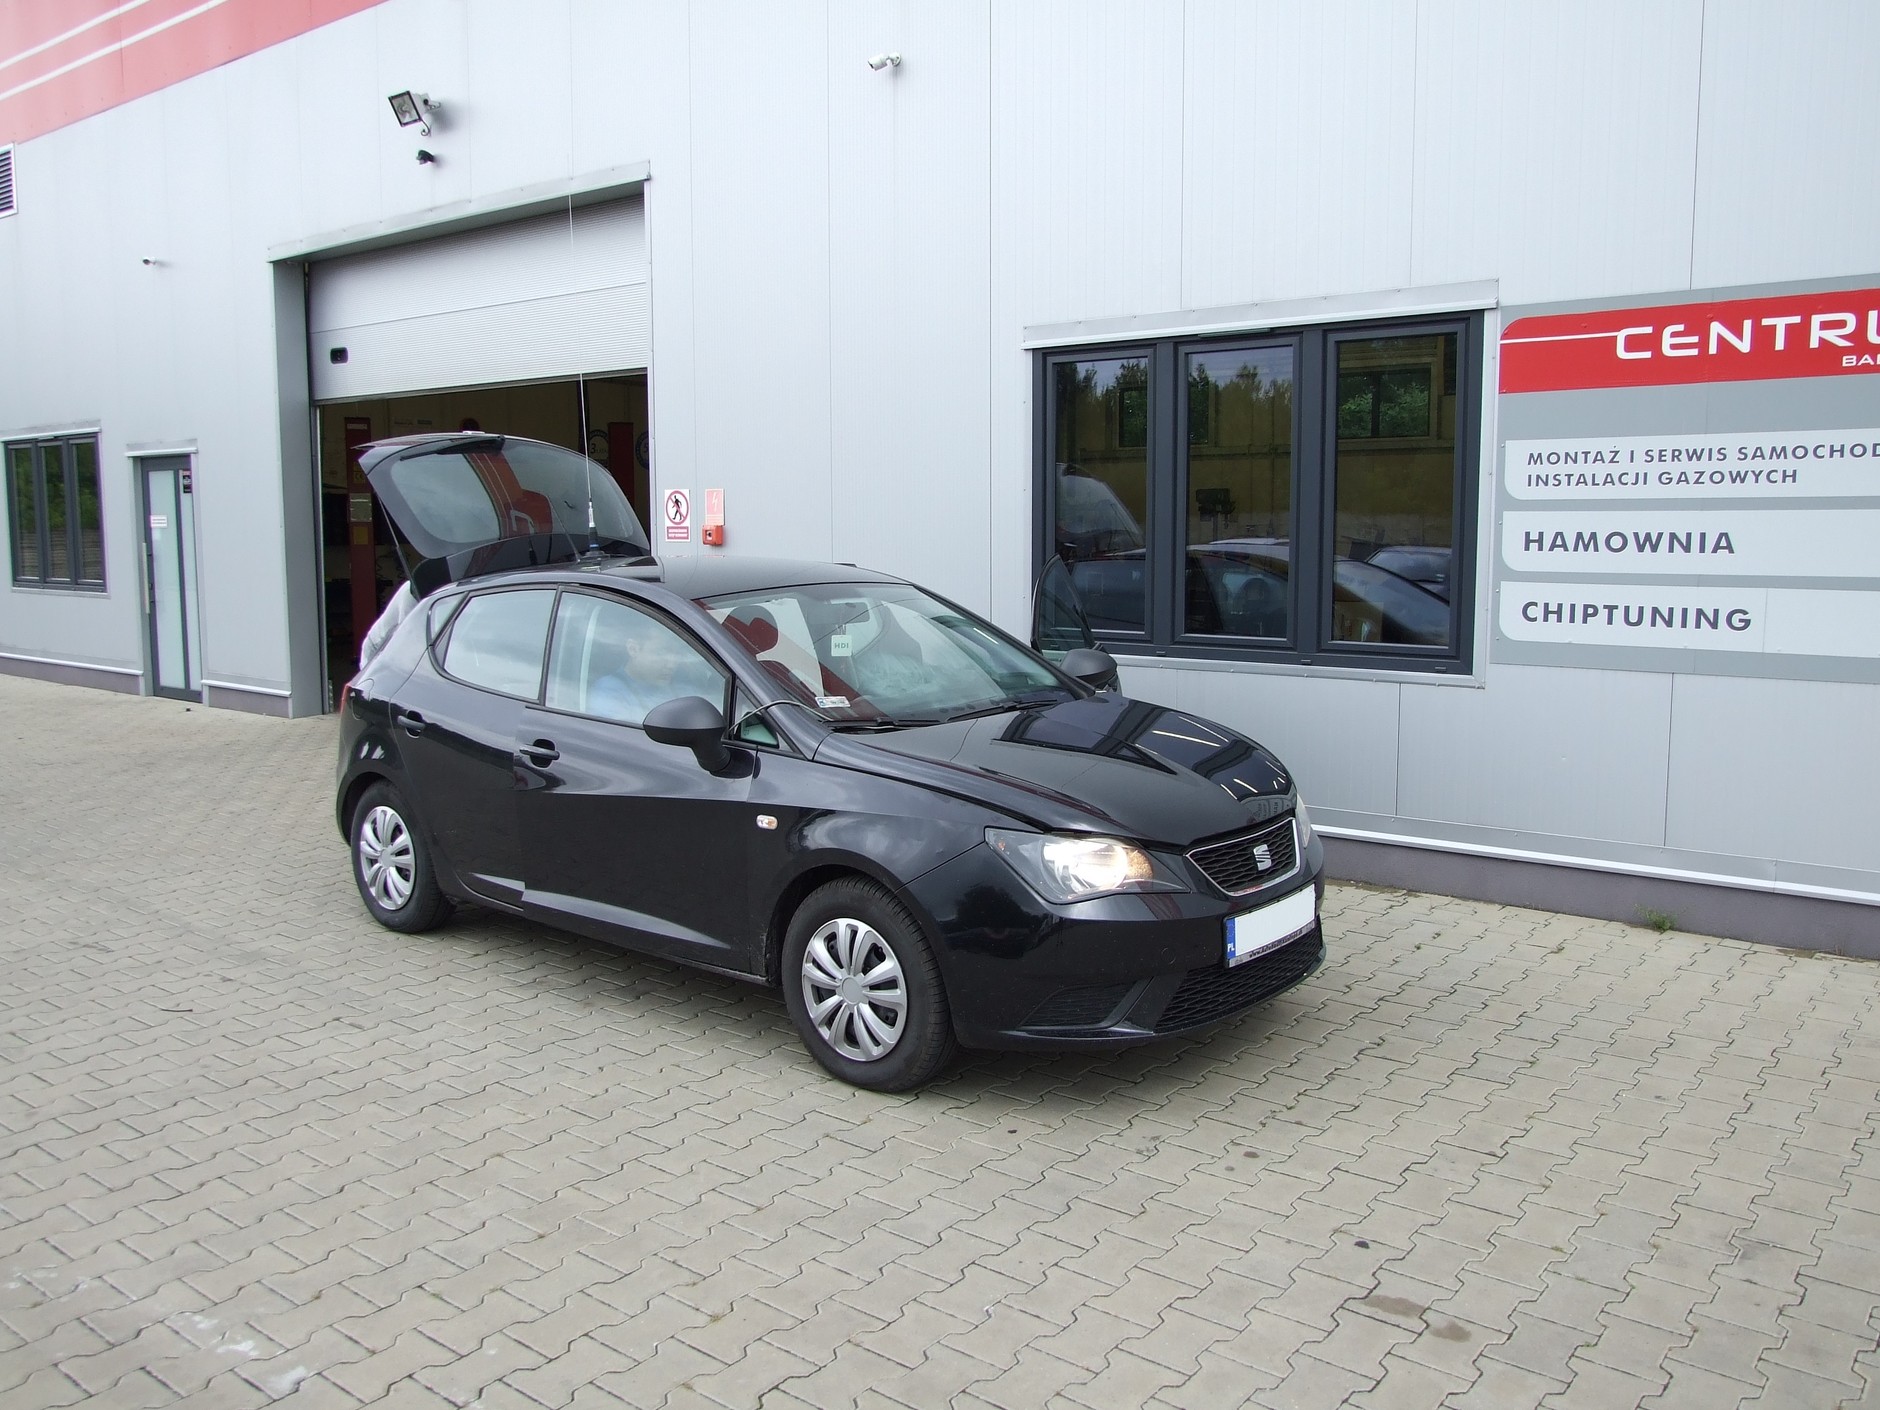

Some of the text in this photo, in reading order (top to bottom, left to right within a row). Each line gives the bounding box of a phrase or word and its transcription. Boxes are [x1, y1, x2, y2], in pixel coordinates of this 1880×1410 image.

[1842, 354, 1880, 367] BA
[1527, 446, 1620, 466] MONTAŻ
[1629, 449, 1635, 464] I
[1644, 447, 1727, 463] SERWIS
[1527, 469, 1797, 488] INSTALACJI GAZOWYCH
[1524, 531, 1735, 554] HAMOWNIA
[1521, 601, 1752, 632] CHIPTUNING
